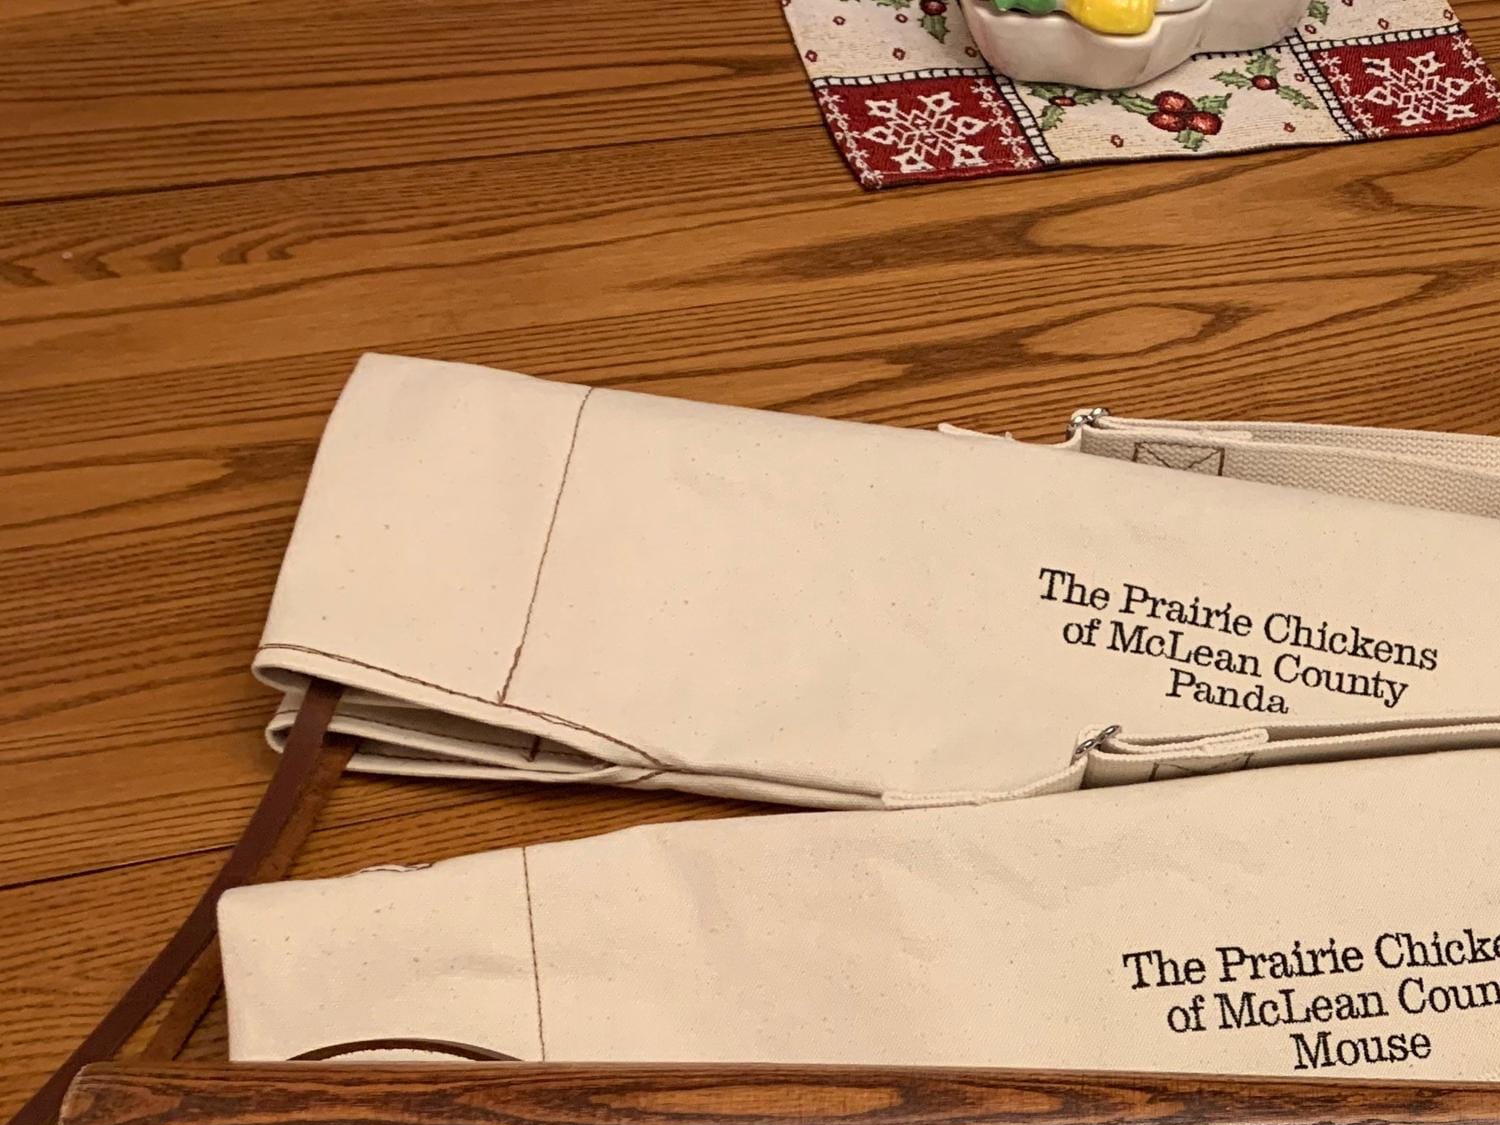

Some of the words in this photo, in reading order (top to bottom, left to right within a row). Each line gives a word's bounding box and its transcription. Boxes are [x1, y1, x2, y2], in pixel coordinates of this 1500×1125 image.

[1037, 566, 1111, 612] The
[1117, 582, 1254, 638] Prairie
[1262, 612, 1439, 672] Chickens
[1061, 617, 1103, 648] of
[1105, 619, 1263, 679] McLean
[1273, 652, 1410, 710] County
[1164, 666, 1291, 716] Panda
[1121, 948, 1208, 991] The
[1214, 936, 1365, 984] Prairie
[1166, 993, 1208, 1034] of
[1212, 987, 1391, 1031] McLean
[1288, 1030, 1433, 1072] Mouse
